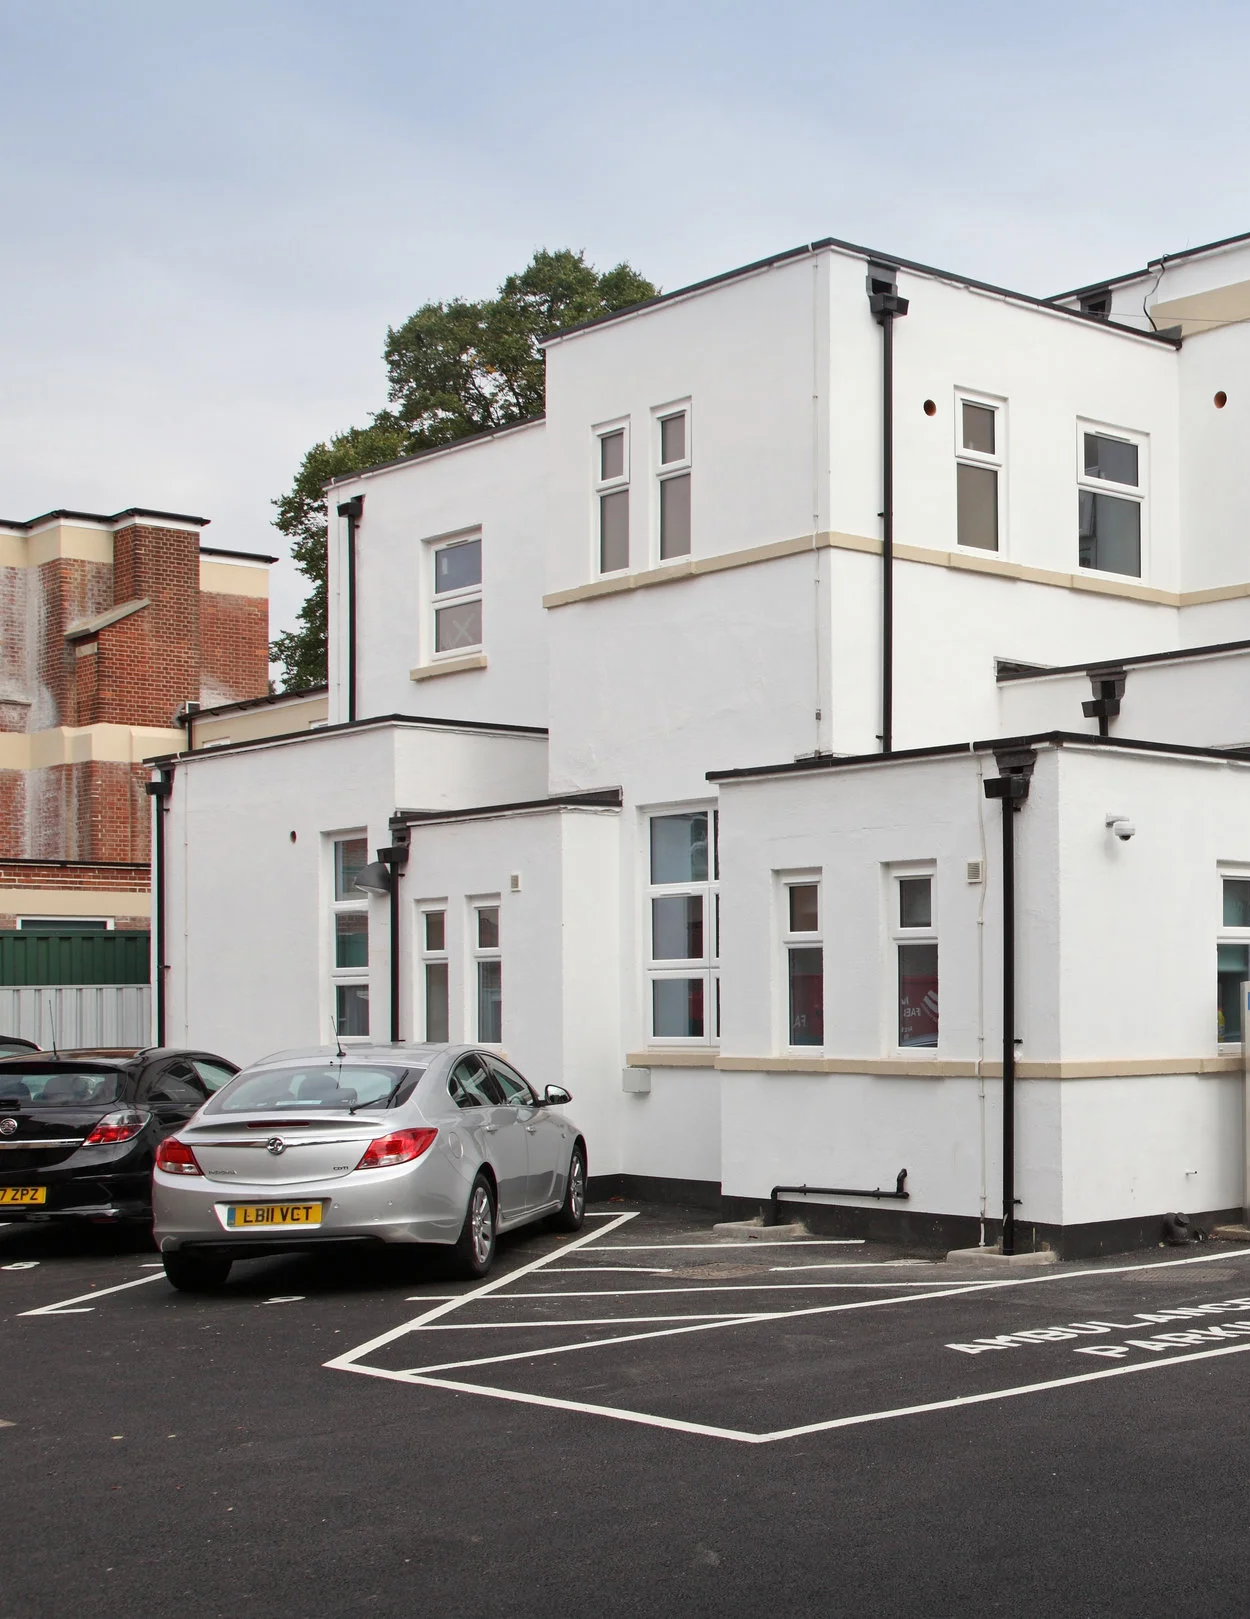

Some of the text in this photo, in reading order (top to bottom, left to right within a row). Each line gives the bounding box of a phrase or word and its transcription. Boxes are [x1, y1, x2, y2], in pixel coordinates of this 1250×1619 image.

[11, 1188, 39, 1201] ZPZ
[243, 1206, 313, 1224] LB11 VCT
